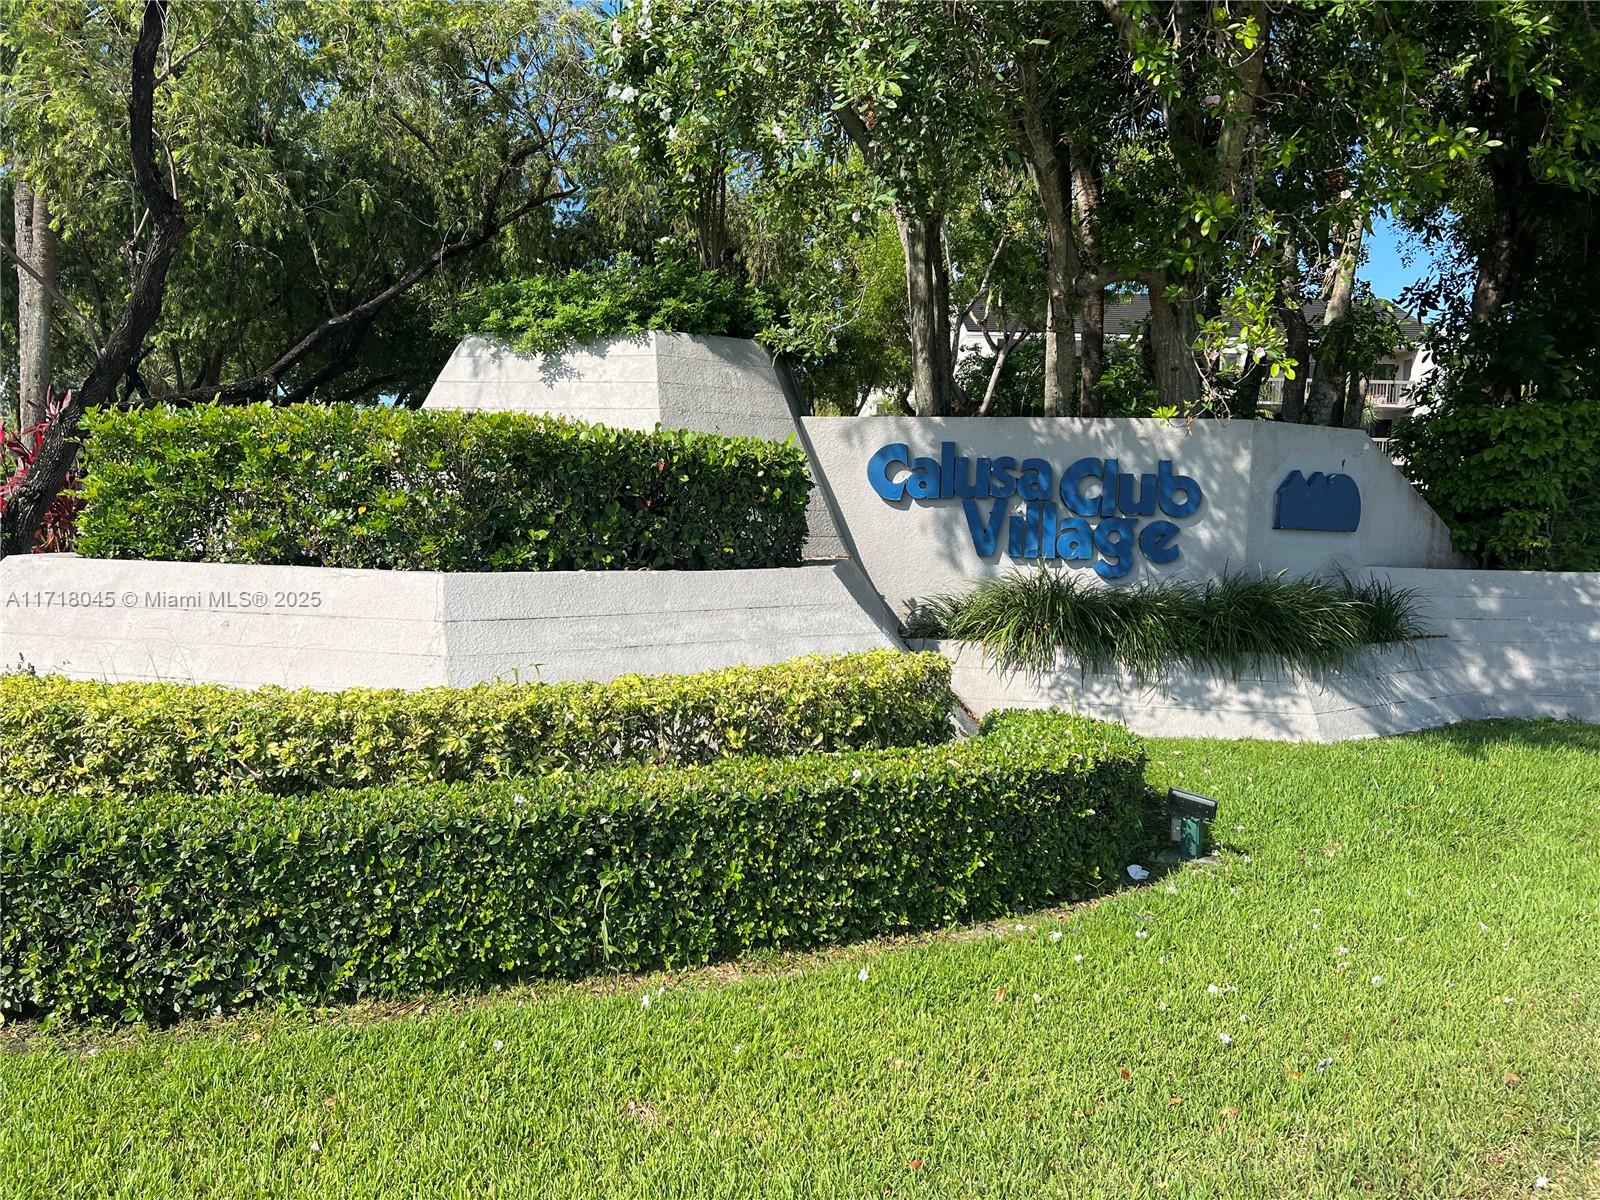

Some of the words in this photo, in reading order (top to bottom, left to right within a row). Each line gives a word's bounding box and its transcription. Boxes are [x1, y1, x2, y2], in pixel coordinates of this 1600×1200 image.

[867, 441, 1055, 501] Calusa
[1060, 457, 1204, 518] Club
[963, 500, 1181, 579] Village
